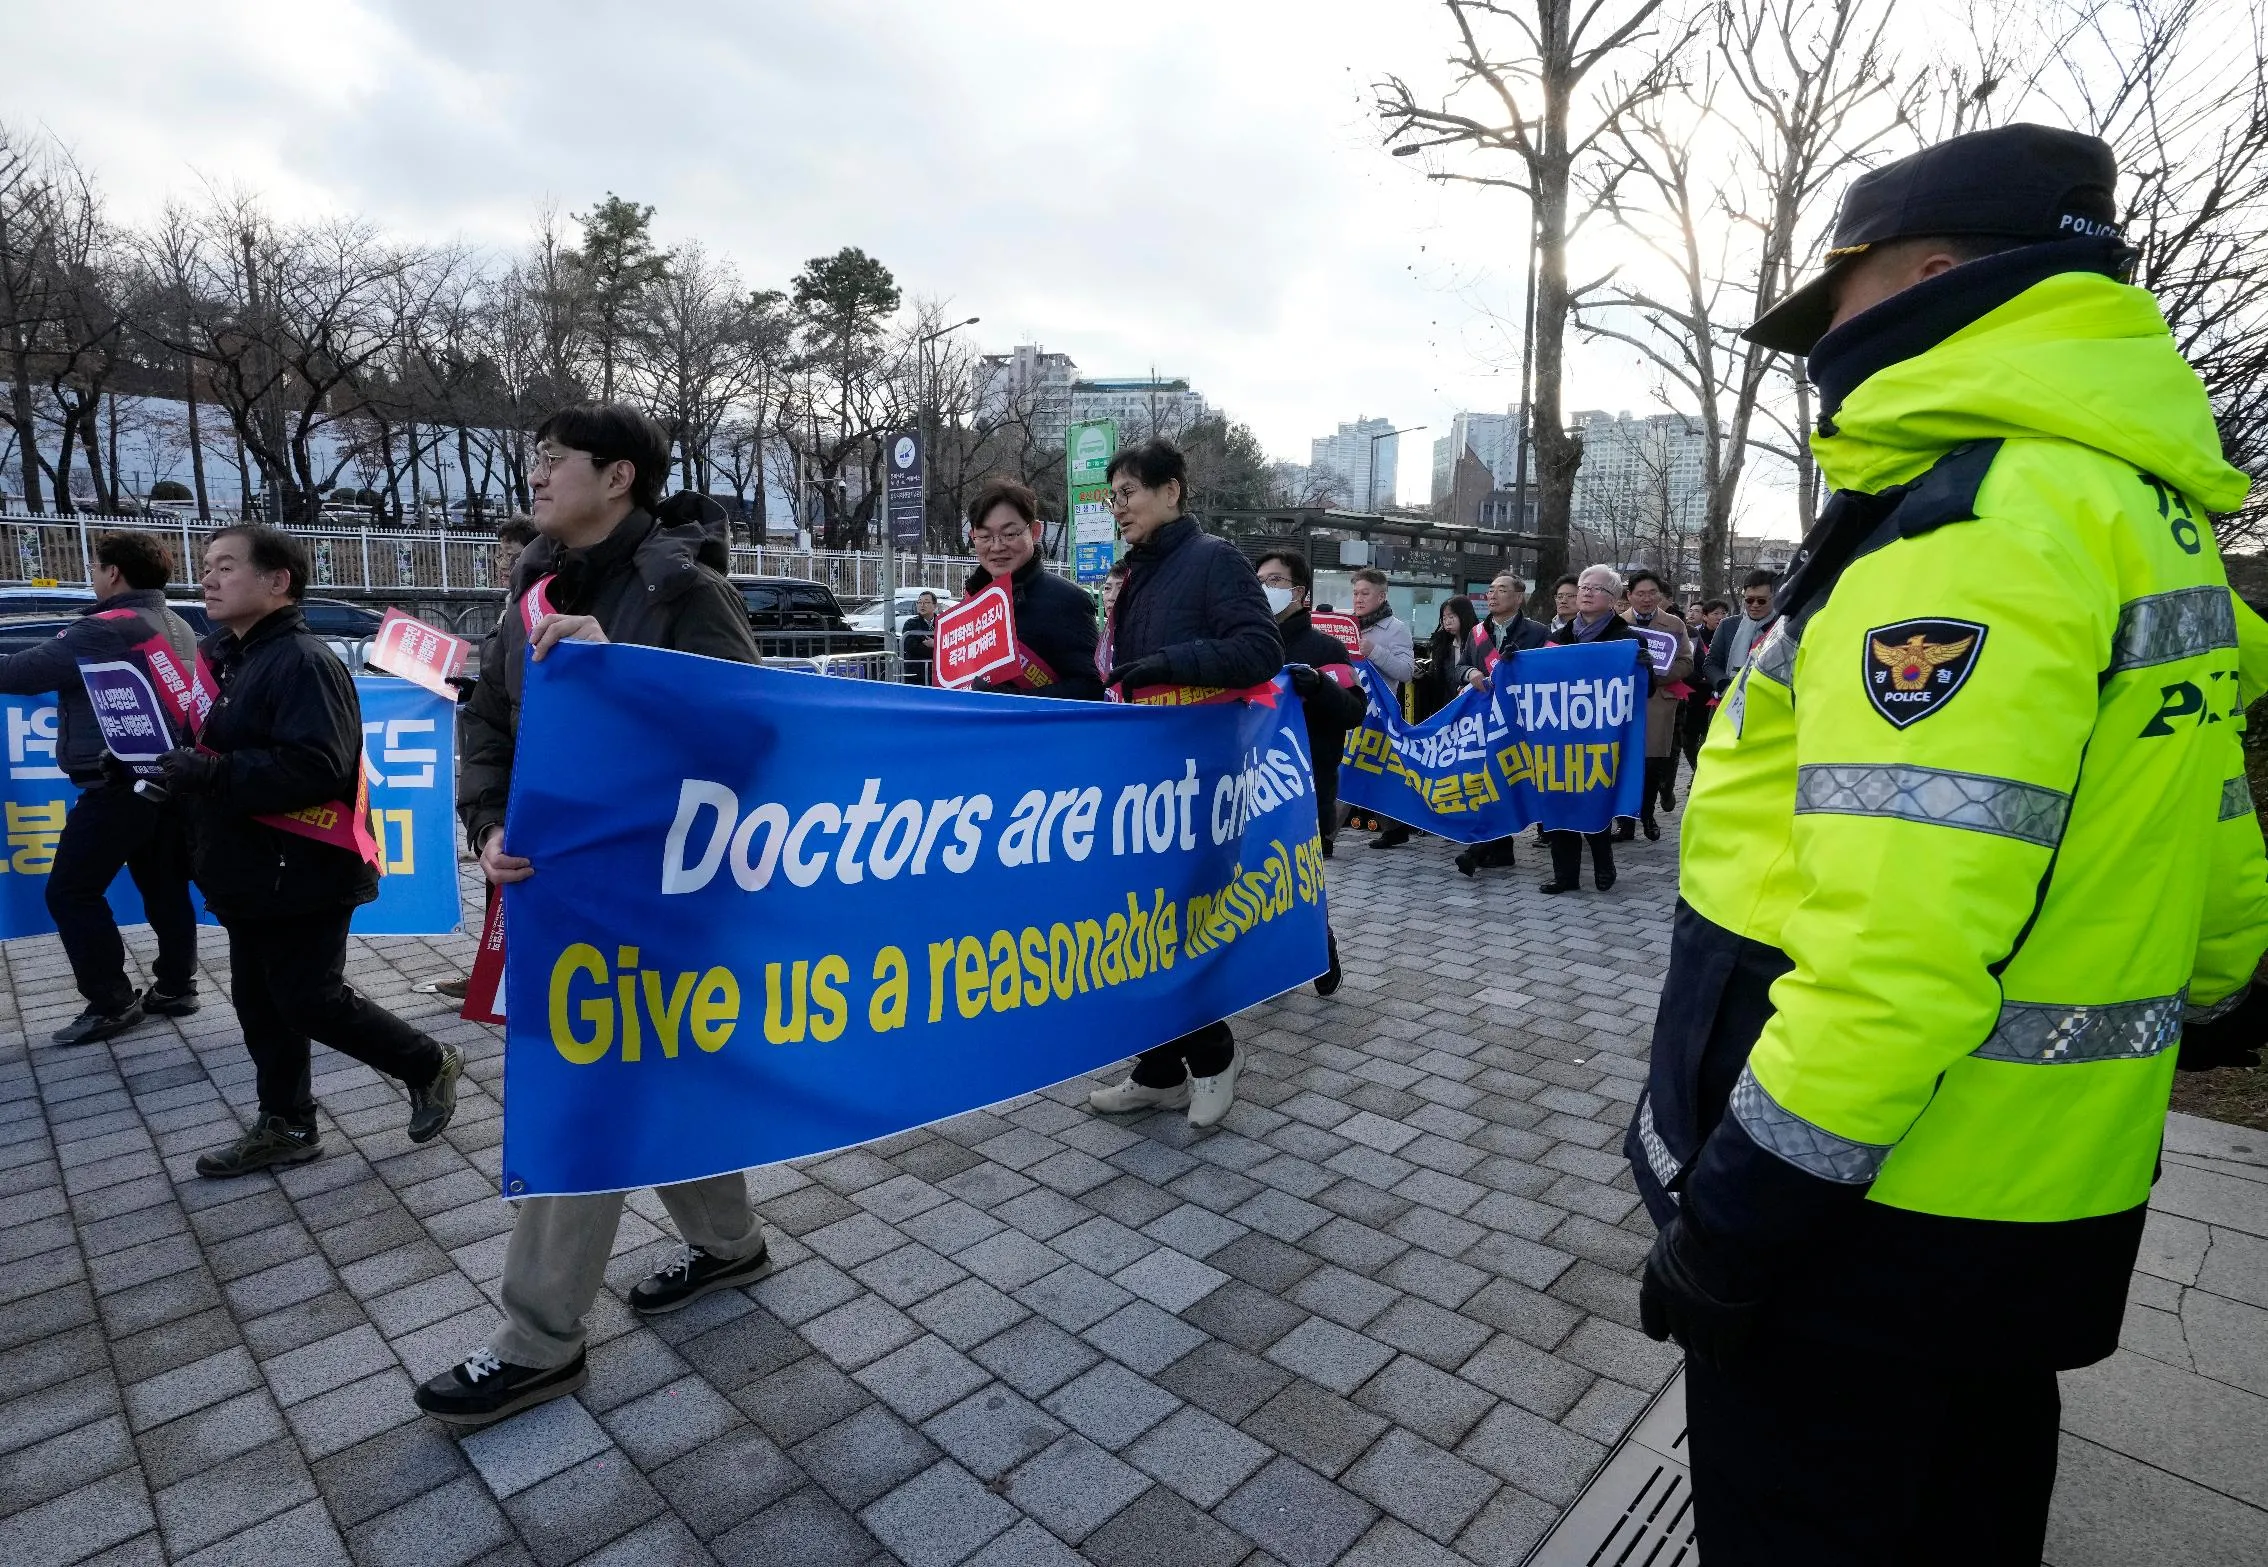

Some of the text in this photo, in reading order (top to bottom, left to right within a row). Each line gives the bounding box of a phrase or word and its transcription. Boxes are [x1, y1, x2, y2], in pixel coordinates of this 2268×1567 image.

[2059, 214, 2118, 238] POLICE
[942, 603, 1003, 649] 비과학적 수요조사
[949, 629, 997, 667] 즉각 폐기하라
[148, 650, 186, 694] 의대정원
[1023, 663, 1054, 688] 의료
[1873, 668, 1954, 684] 경 찰
[104, 687, 140, 711] 의정합의
[1505, 675, 1635, 732] 저지하여
[1884, 691, 1932, 703] POLICE
[101, 714, 157, 738] 정부는 이행하라
[661, 778, 994, 895] Doctors
[997, 786, 1103, 868] are
[1112, 758, 1200, 857] not
[549, 943, 740, 1065] Give
[764, 955, 849, 1044] us
[869, 946, 908, 1032] a
[928, 888, 1179, 1023] reasonable
[1184, 839, 1294, 960] medical
